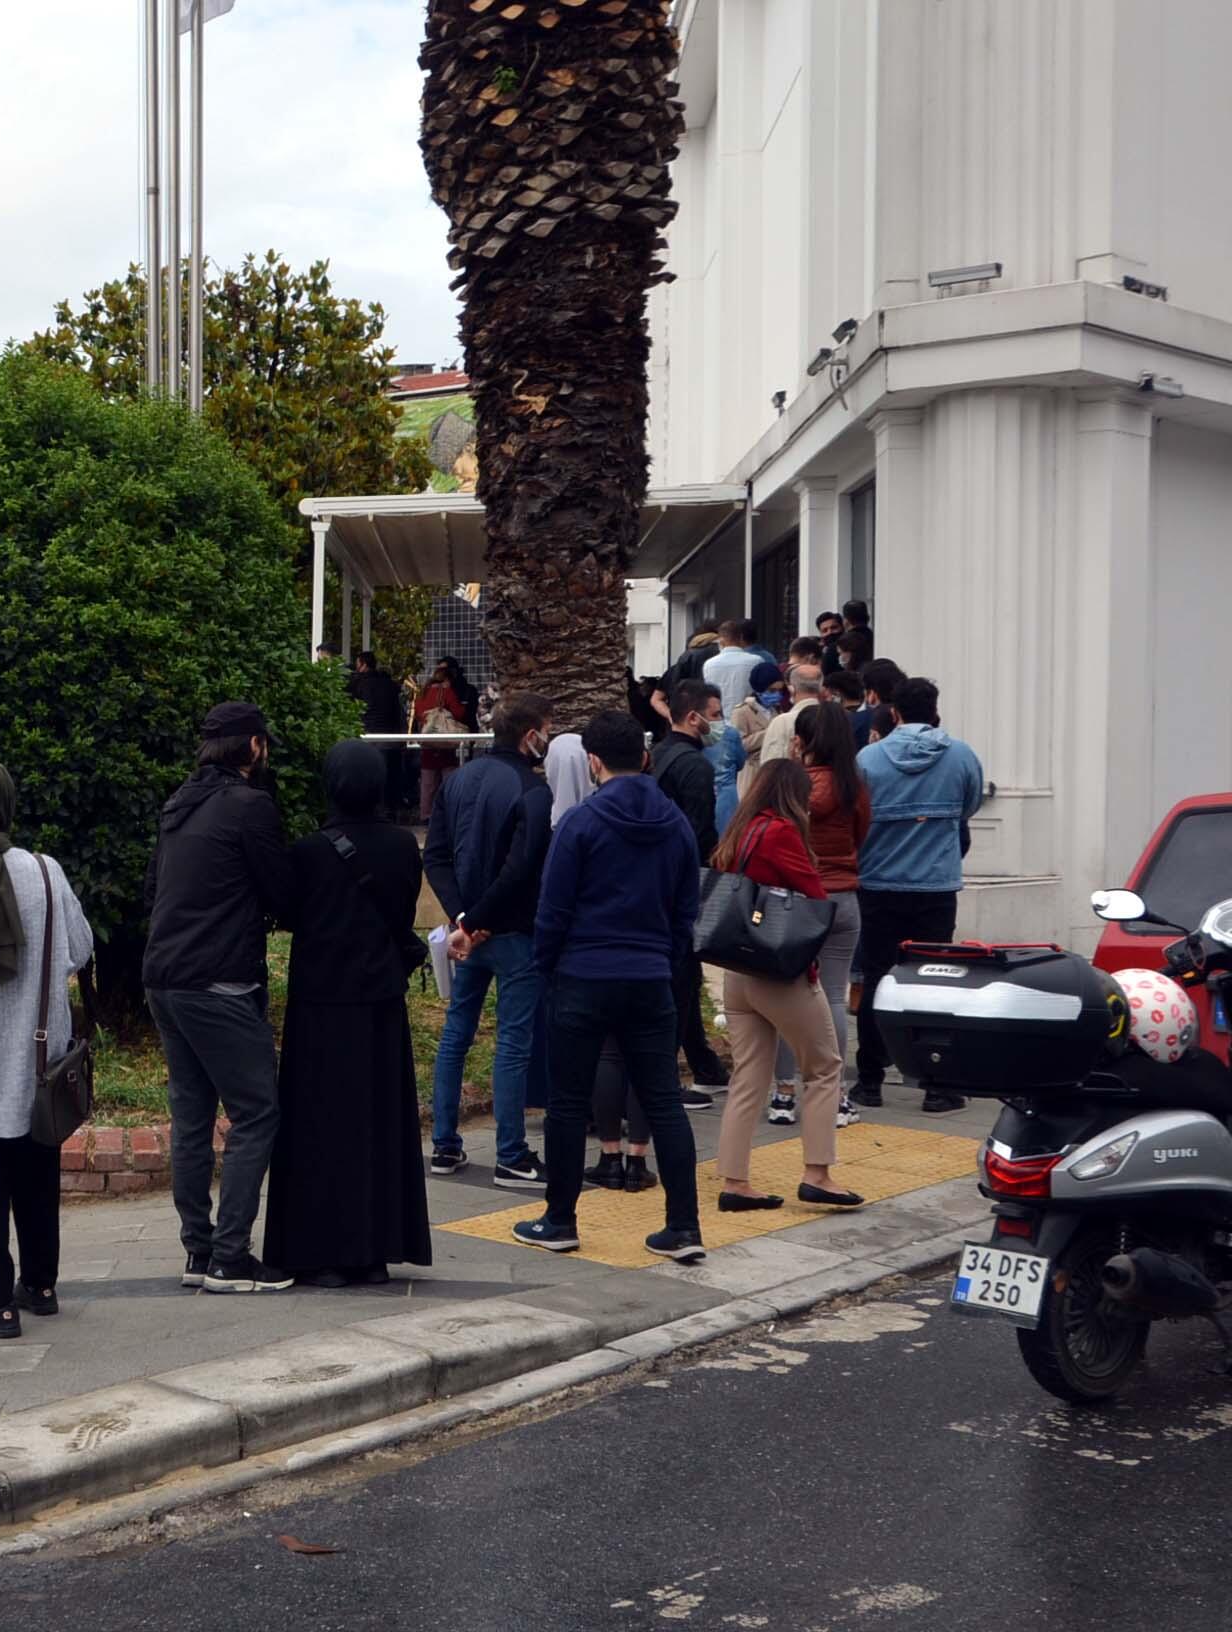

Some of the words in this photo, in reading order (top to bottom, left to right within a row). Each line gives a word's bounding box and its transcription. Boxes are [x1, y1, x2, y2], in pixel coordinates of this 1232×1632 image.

[965, 1249, 992, 1274] 34
[998, 1255, 1042, 1283] DFS
[979, 1280, 1021, 1306] 250
